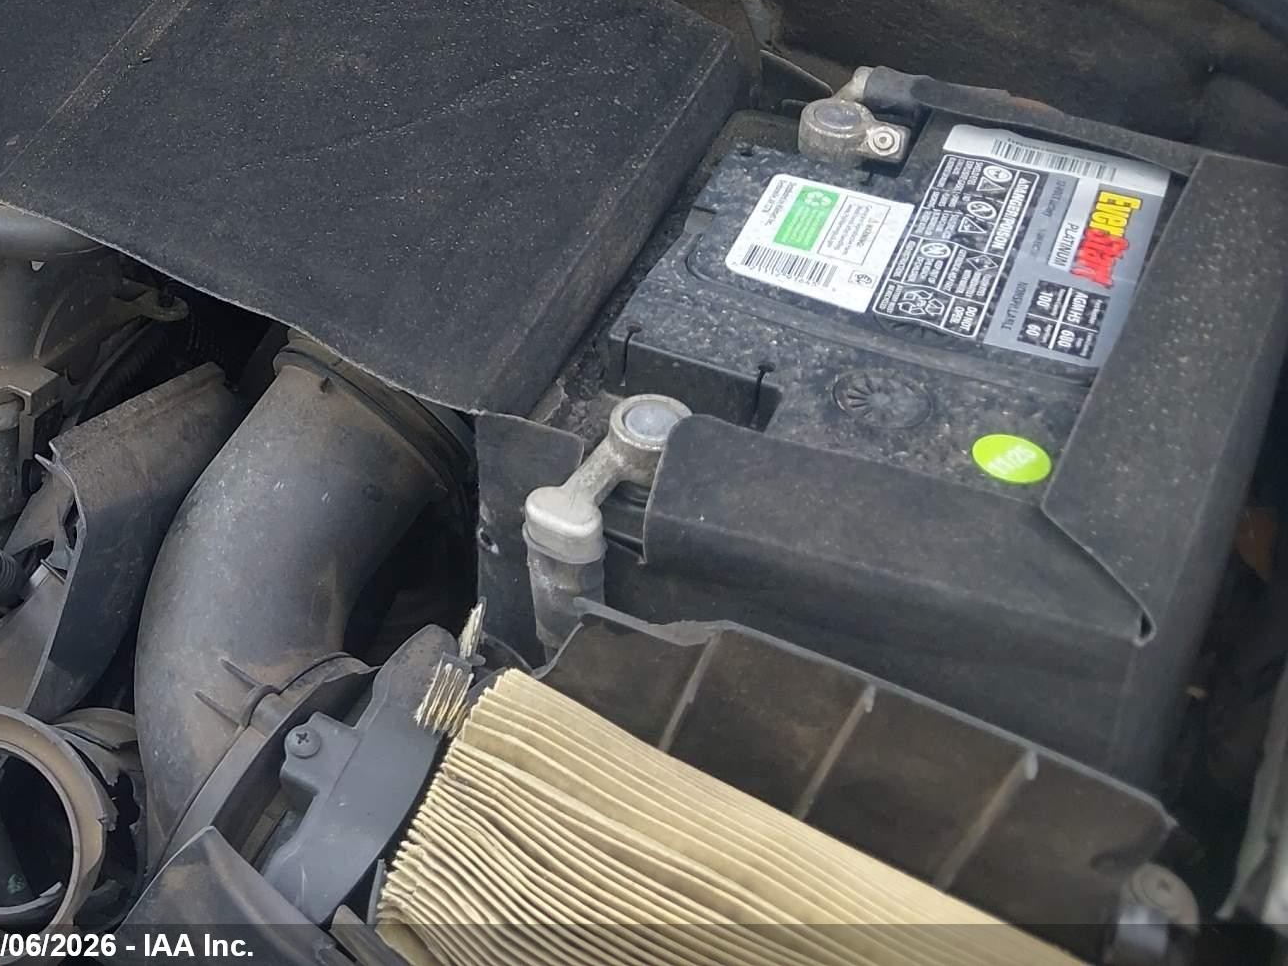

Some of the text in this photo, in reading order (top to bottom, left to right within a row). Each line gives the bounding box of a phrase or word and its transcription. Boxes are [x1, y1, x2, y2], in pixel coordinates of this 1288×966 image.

[1055, 222, 1080, 267] PLATINUM
[1069, 190, 1143, 288] EverStart
[1035, 290, 1054, 307] 100
[1069, 291, 1090, 312] AGM
[957, 305, 977, 331] DO NOT
[1023, 323, 1042, 336] 60
[1055, 328, 1076, 348] 680
